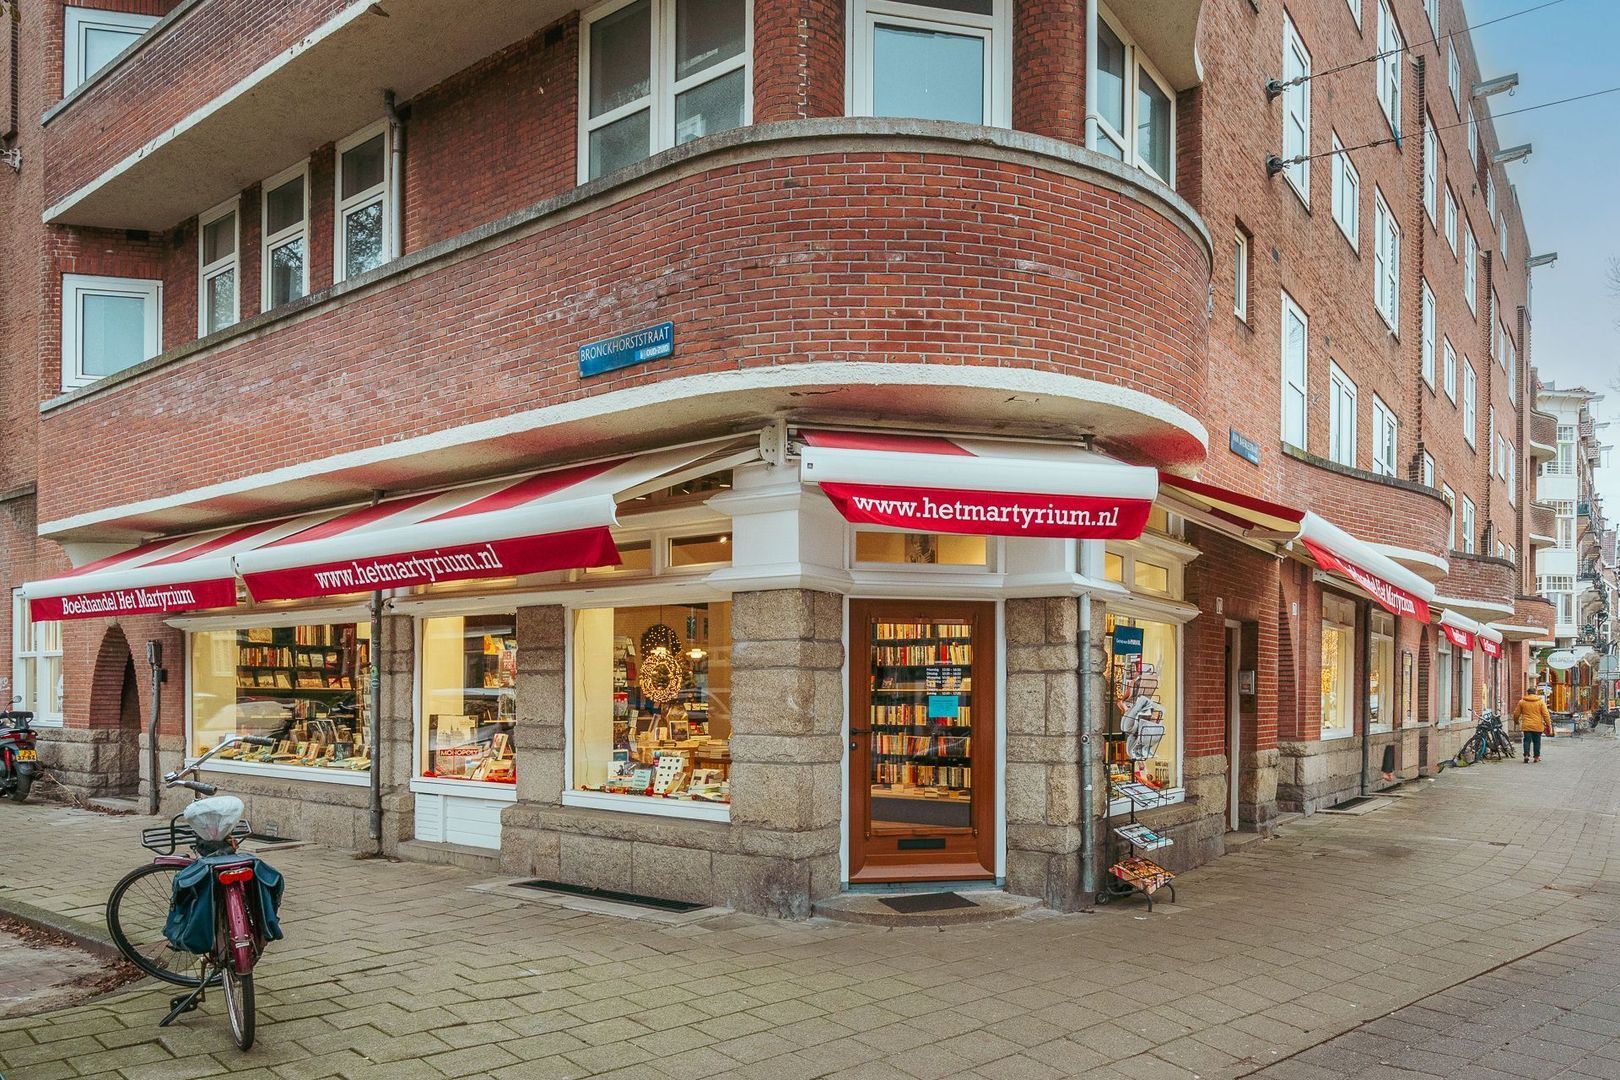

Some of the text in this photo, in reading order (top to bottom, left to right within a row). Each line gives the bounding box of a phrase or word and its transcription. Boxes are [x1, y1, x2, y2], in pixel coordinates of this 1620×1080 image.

[581, 326, 669, 362] BRONCKHORSTSTRAAT
[852, 497, 1119, 528] www.hetmartyrium.nl
[314, 543, 503, 589] www.hetmartyrium.nl
[62, 587, 195, 615] Boekhandel Het Martyrium
[1385, 583, 1416, 615] Martyrium
